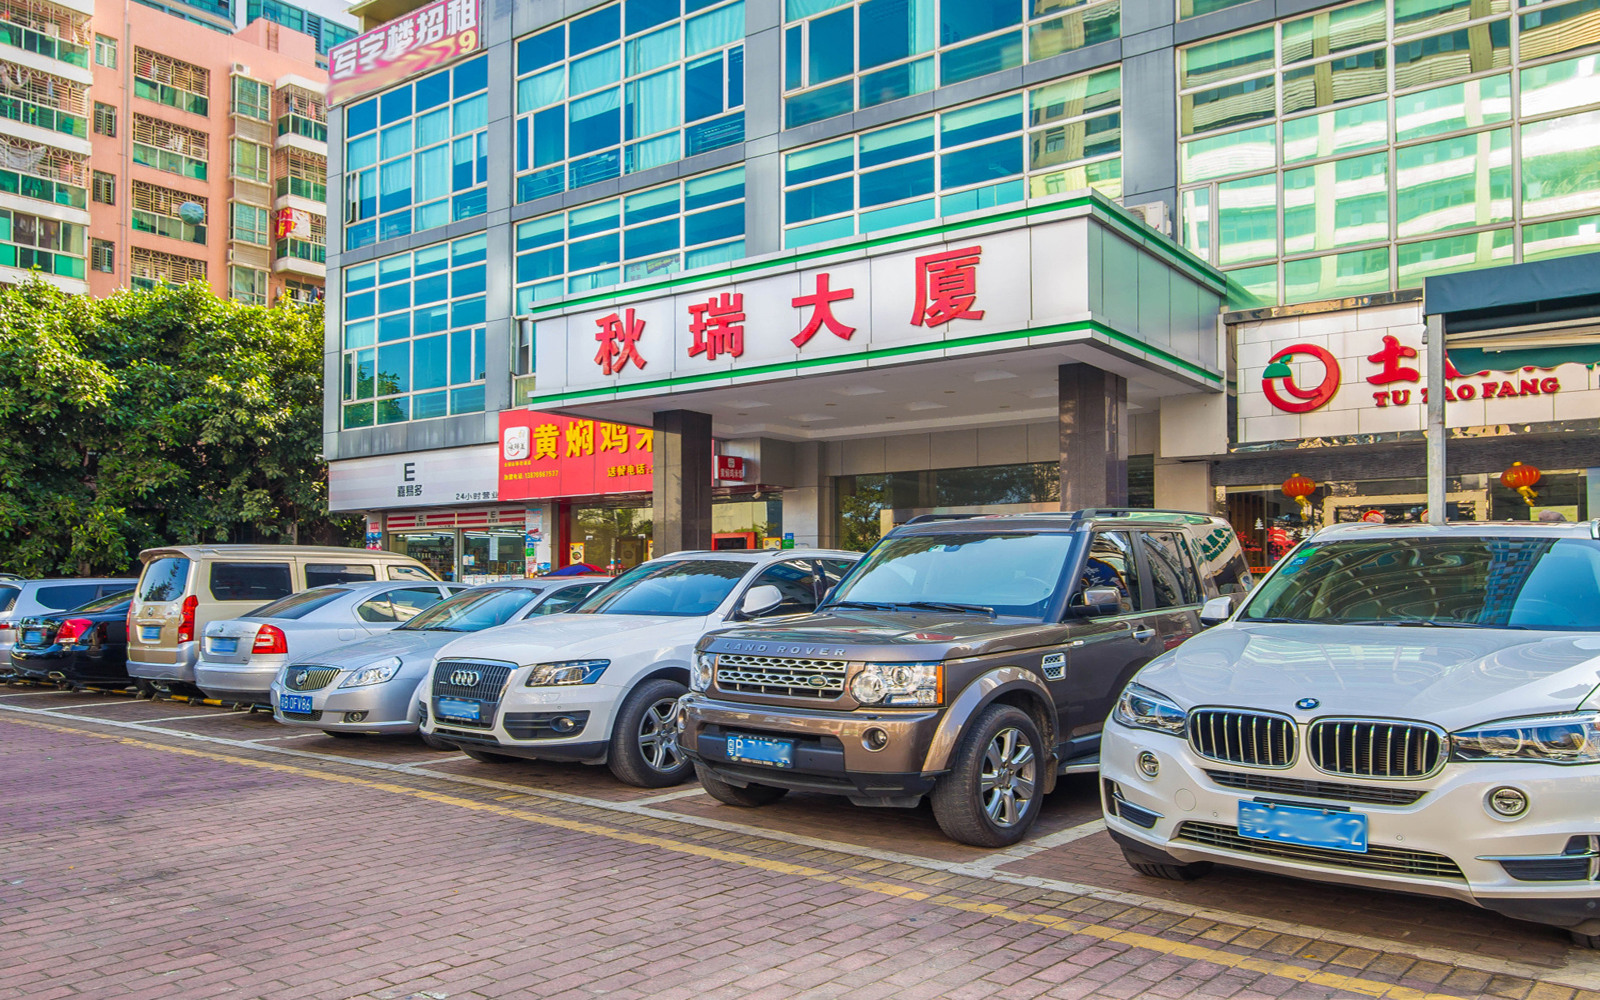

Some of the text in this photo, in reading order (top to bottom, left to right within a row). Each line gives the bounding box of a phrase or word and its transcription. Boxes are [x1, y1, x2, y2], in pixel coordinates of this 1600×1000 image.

[332, 0, 477, 80] 写字楼招租
[594, 245, 985, 375] 秋瑞大厦
[1373, 390, 1410, 407] TU
[1481, 377, 1560, 399] FANG
[404, 462, 415, 481] E
[607, 463, 654, 477] 送餐电话:
[723, 642, 846, 657] LAND ROVER
